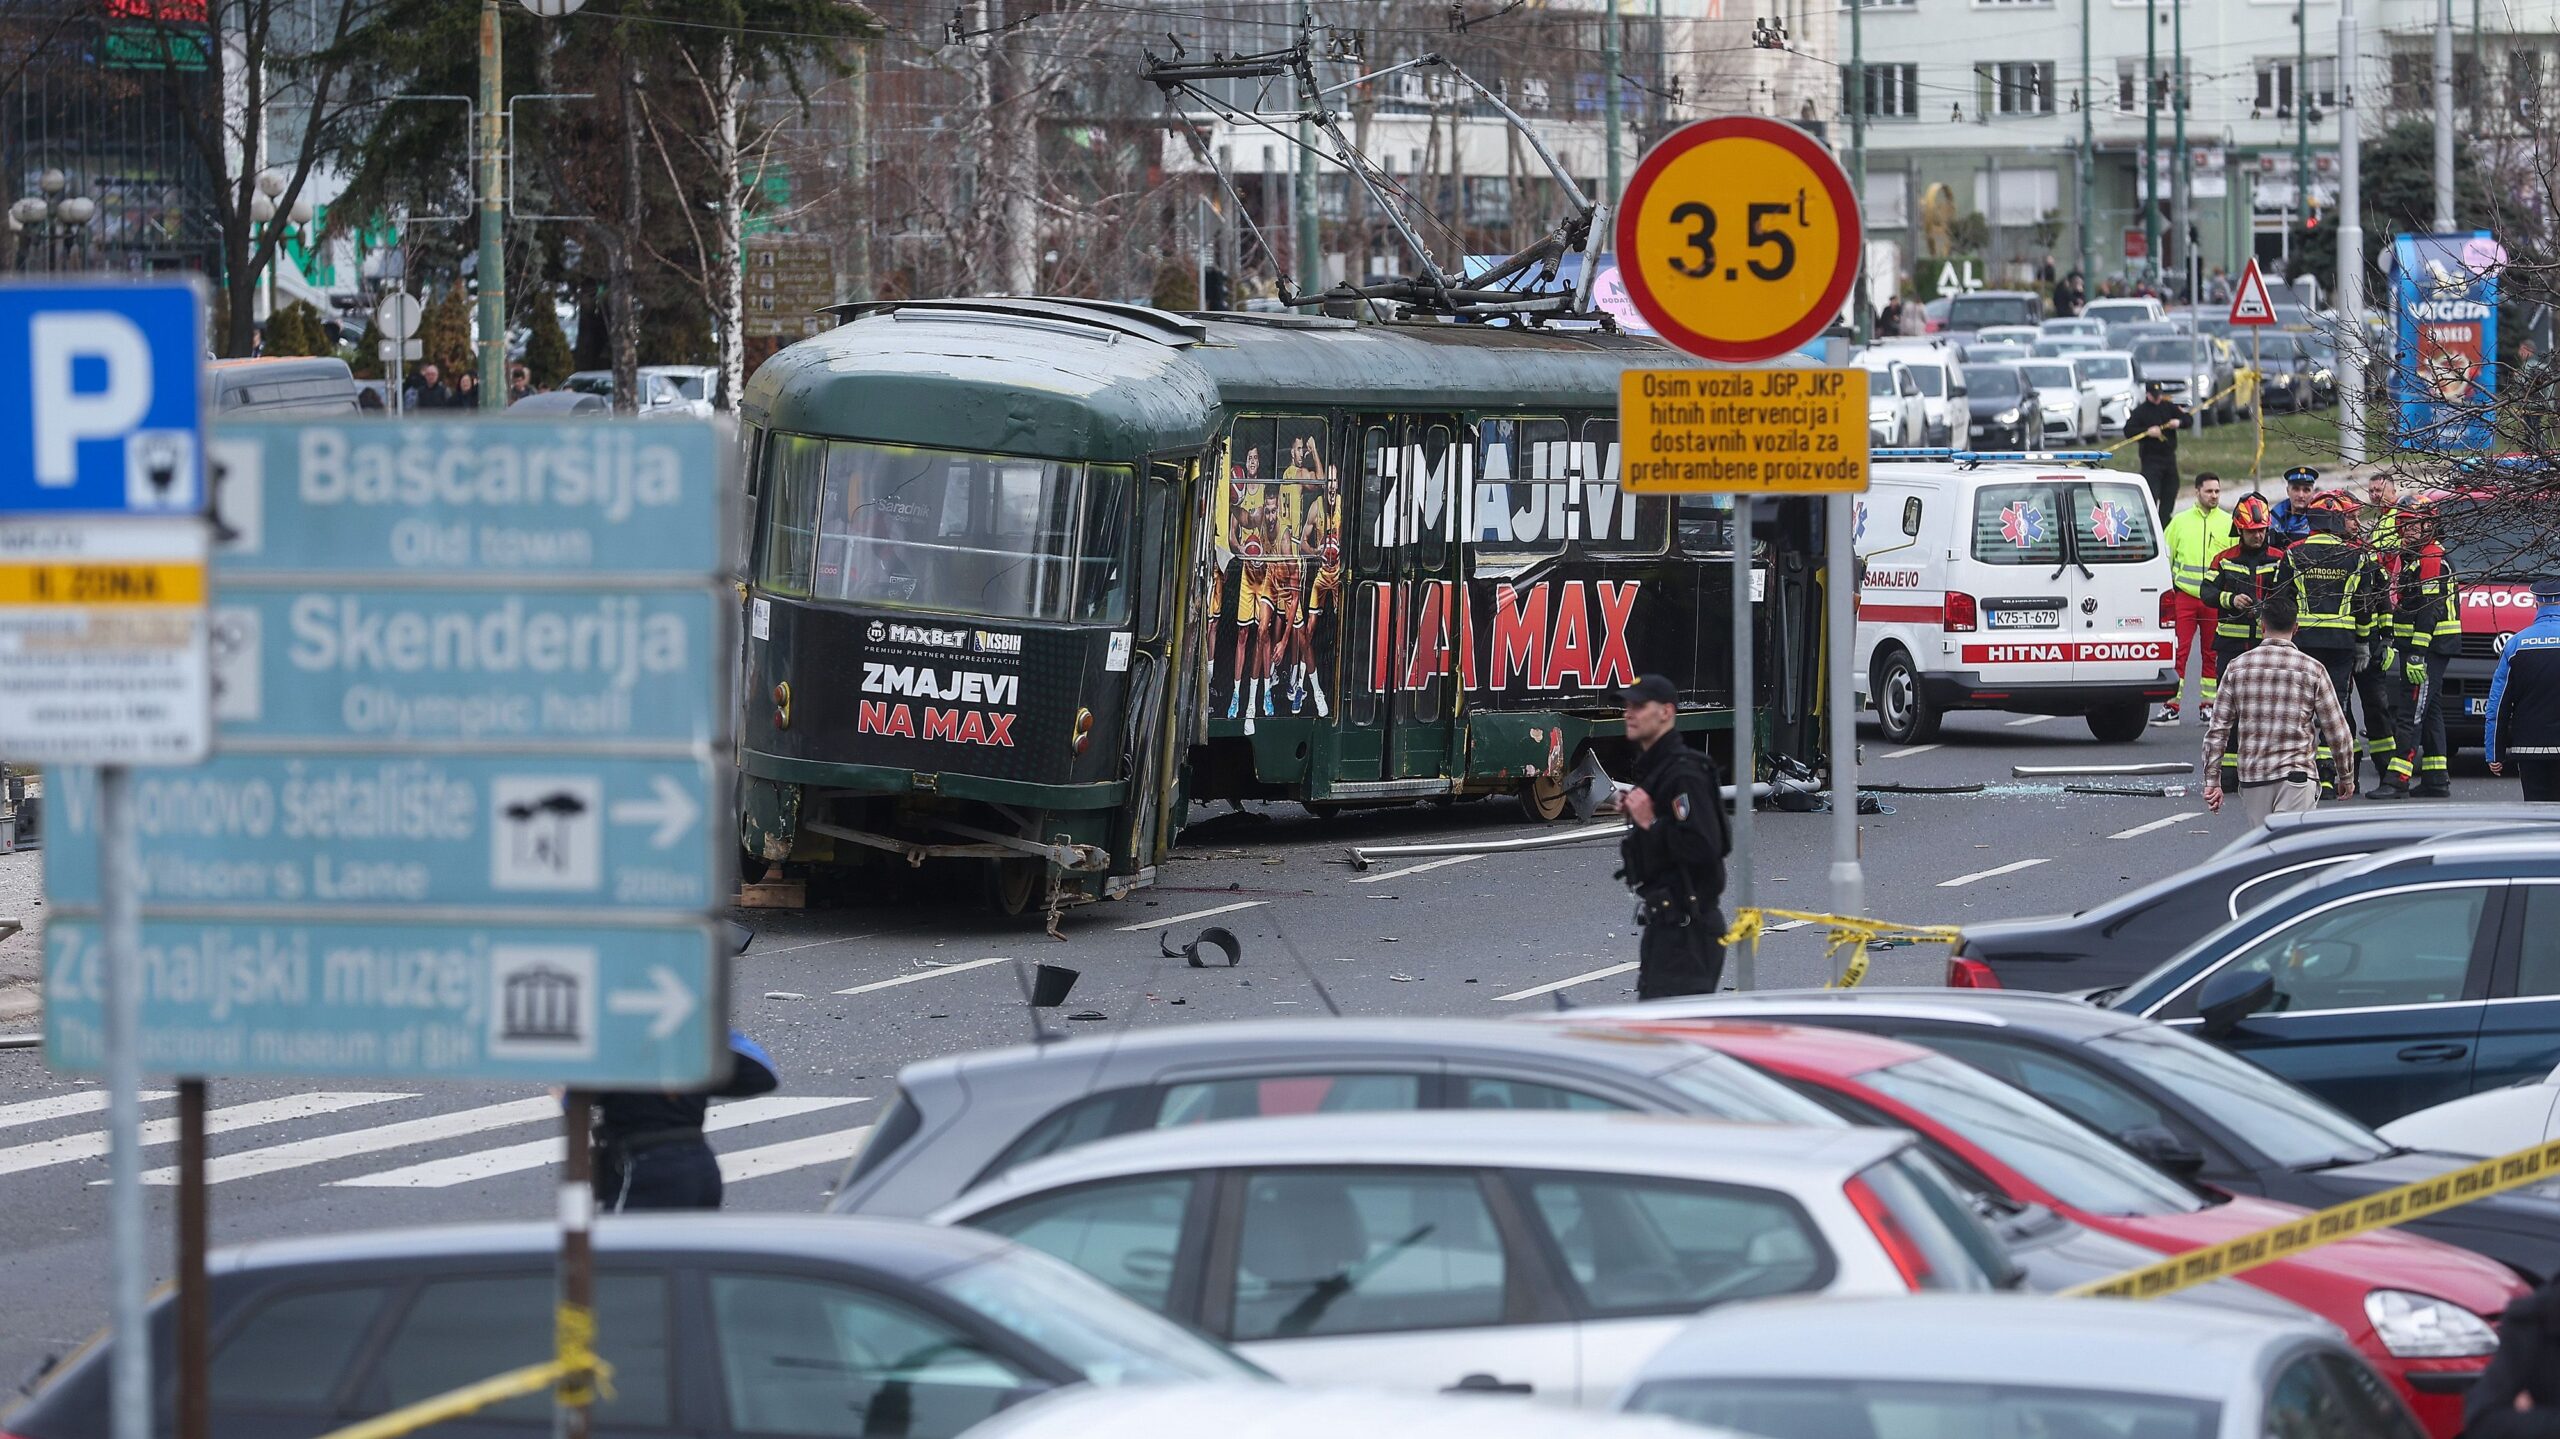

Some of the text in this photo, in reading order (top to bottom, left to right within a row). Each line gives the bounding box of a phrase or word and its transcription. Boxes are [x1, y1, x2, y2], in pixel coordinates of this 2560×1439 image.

[29, 311, 155, 489] P
[1643, 374, 1690, 397] Osim
[1698, 374, 1753, 397] vozila
[1650, 402, 1839, 430] hitnih intervencija i
[1651, 430, 1839, 452] dostavnih vozila za
[299, 428, 682, 524] Baščaršija
[1630, 458, 1860, 485] prehrambene proizvode
[391, 518, 592, 566] Old town
[1864, 571, 1919, 587] SARAJEVO
[1490, 580, 1641, 690] MAX
[1996, 611, 2056, 624] K75-T-679
[289, 596, 686, 693] Skenderija
[864, 645, 1020, 666] PREMIUM PARTNER REPREZENTACIJE
[986, 633, 1022, 651] KSBIH
[1988, 646, 2063, 661] HITNA
[2521, 637, 2559, 646] POLICI
[861, 662, 1019, 706] ZMAJEVI
[343, 684, 632, 742] Olympic hall
[857, 700, 1017, 747] NA MAX
[282, 760, 479, 840] šetalište
[313, 855, 430, 899] Lane
[323, 933, 488, 1024] muzej
